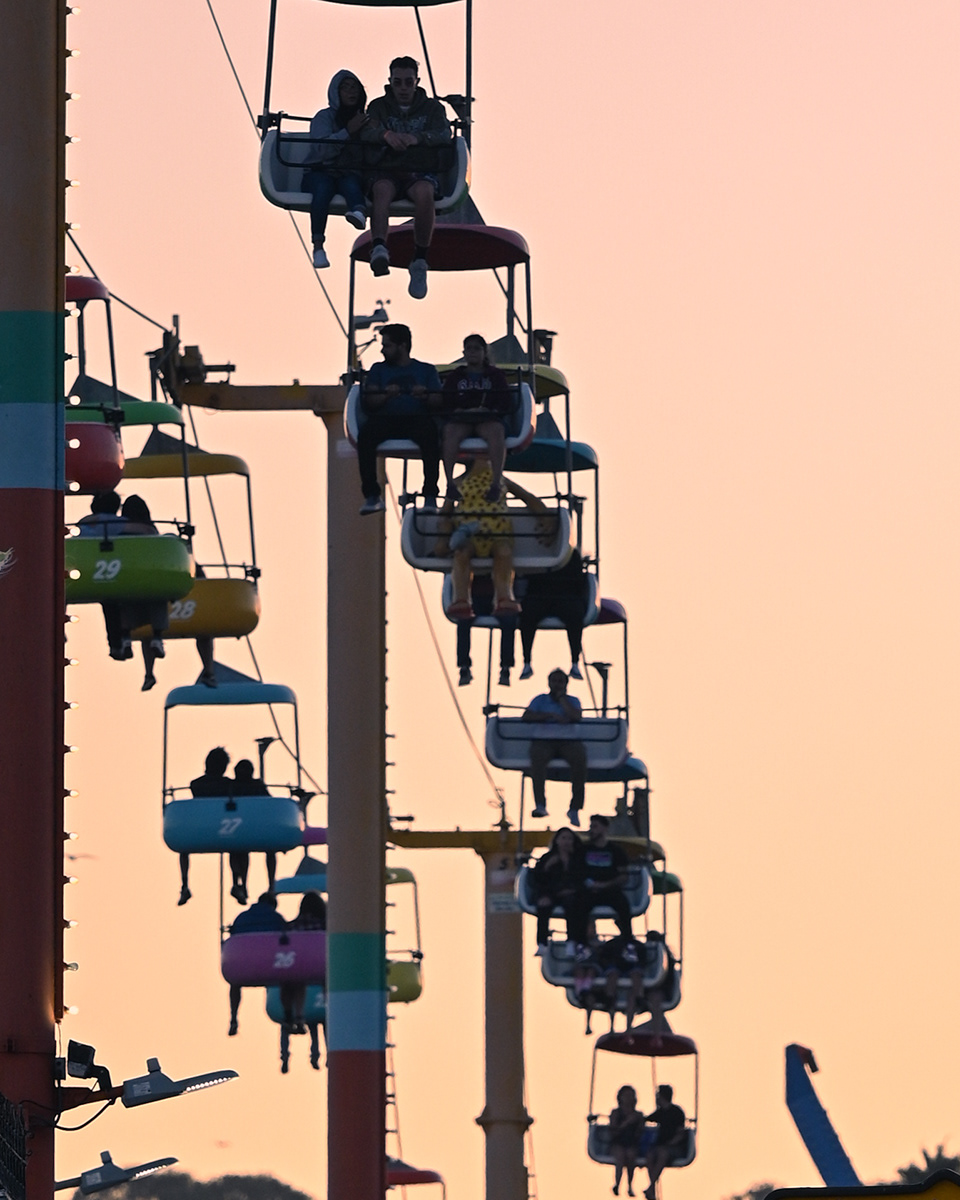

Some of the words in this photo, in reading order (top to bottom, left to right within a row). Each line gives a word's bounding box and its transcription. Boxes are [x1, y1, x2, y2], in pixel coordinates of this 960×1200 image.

[93, 559, 121, 580] 29
[170, 600, 196, 619] 28
[219, 818, 242, 835] 27
